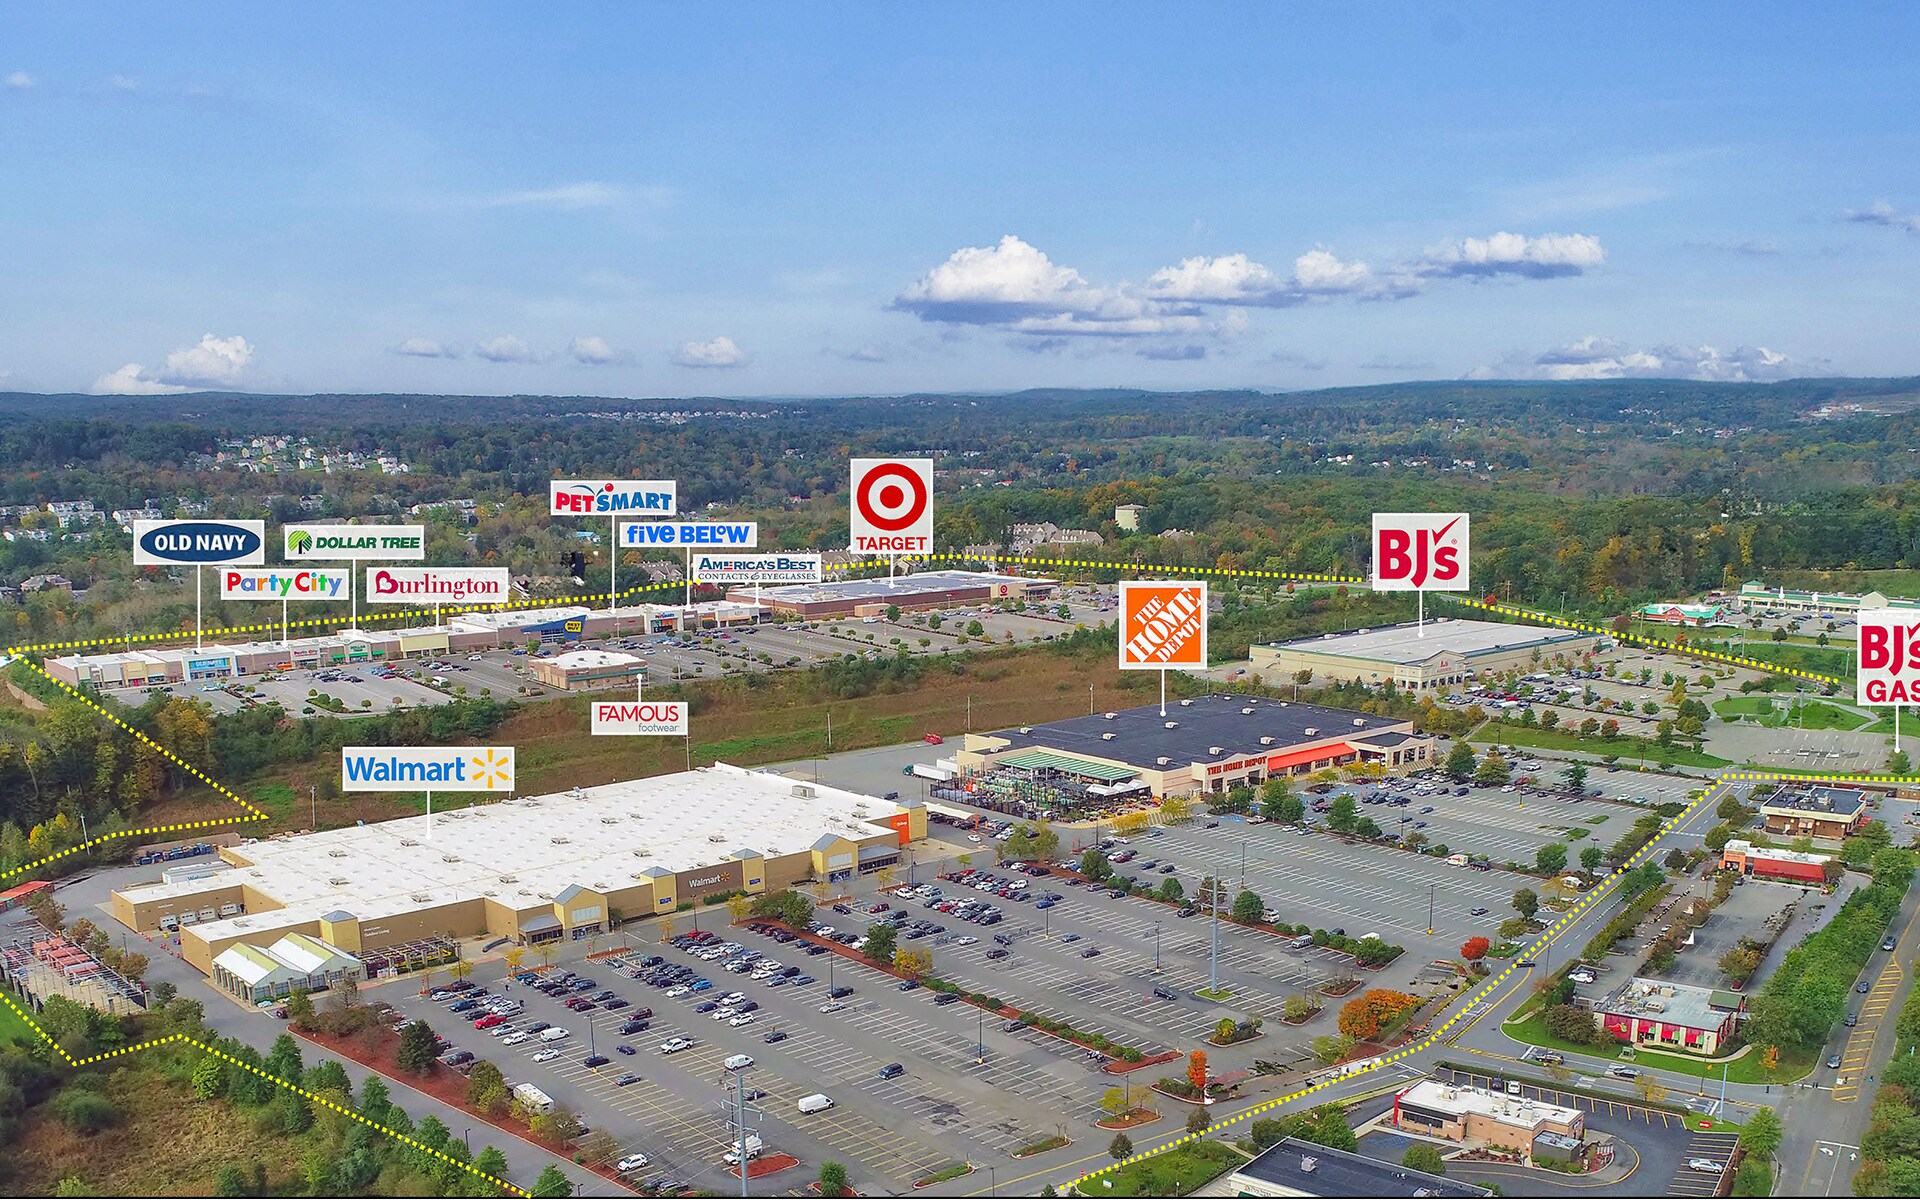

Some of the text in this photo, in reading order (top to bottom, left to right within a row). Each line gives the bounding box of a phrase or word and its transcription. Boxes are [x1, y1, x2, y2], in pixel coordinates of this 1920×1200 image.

[1207, 756, 1267, 775] THE HOME DEPOT
[689, 874, 720, 888] Walmart
